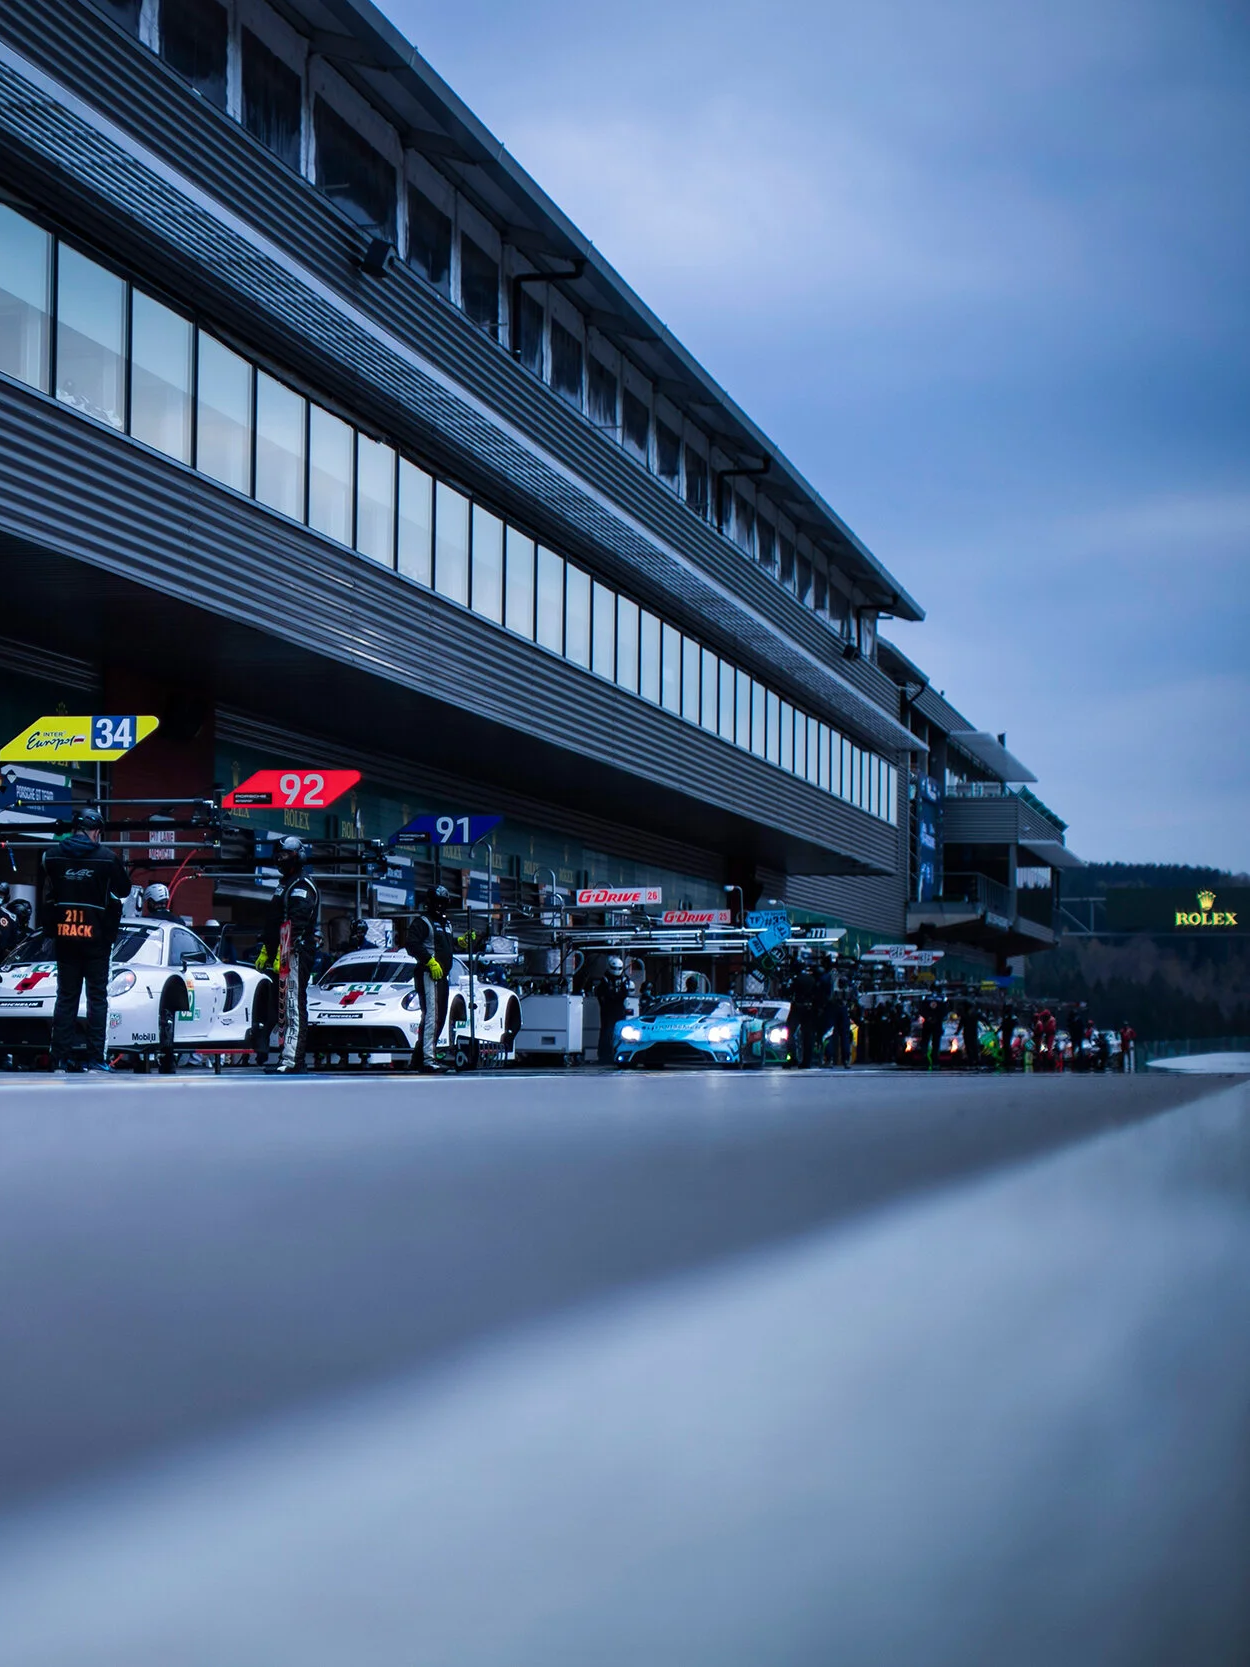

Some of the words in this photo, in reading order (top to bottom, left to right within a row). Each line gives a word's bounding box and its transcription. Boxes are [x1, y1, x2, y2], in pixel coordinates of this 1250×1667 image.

[95, 718, 132, 748] 34
[26, 731, 75, 750] Europol
[16, 785, 35, 800] PORSCHE
[280, 774, 324, 805] 92
[283, 808, 310, 831] ROLEX
[436, 816, 470, 843] 91
[65, 868, 94, 877] WEC
[648, 891, 657, 900] 26
[65, 909, 84, 923] 211
[1175, 912, 1238, 926] ROLEX
[57, 923, 93, 937] TRACK
[132, 1033, 150, 1041] Mobil
